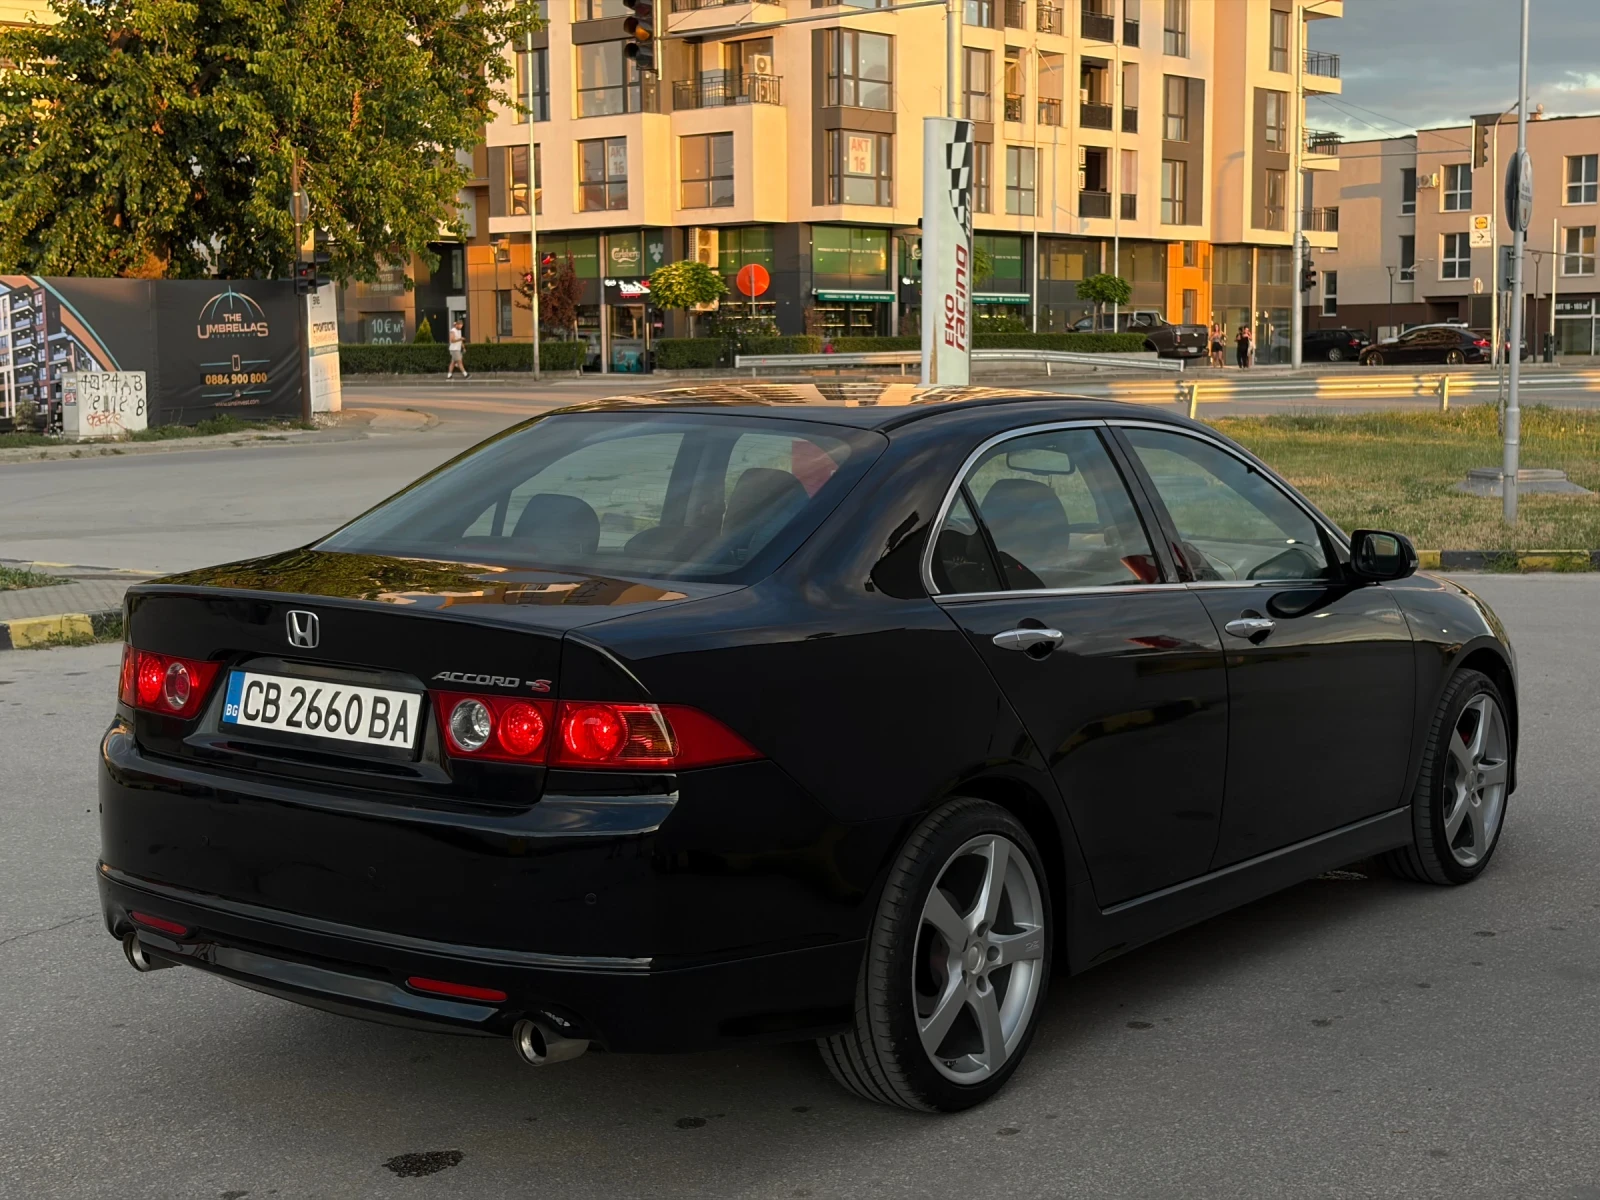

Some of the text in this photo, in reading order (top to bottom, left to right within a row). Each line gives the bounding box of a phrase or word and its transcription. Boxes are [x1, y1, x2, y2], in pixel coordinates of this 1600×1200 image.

[854, 156, 866, 173] 16
[611, 247, 641, 263] Carlsberg
[955, 243, 969, 353] racing
[223, 313, 242, 322] THE
[944, 293, 955, 348] EKO
[197, 322, 269, 339] UMBRELLAS
[205, 372, 268, 385] 0884 900 800
[431, 671, 520, 688] ACCORD
[225, 703, 238, 717] BG
[243, 680, 408, 743] CB 2660 BA
